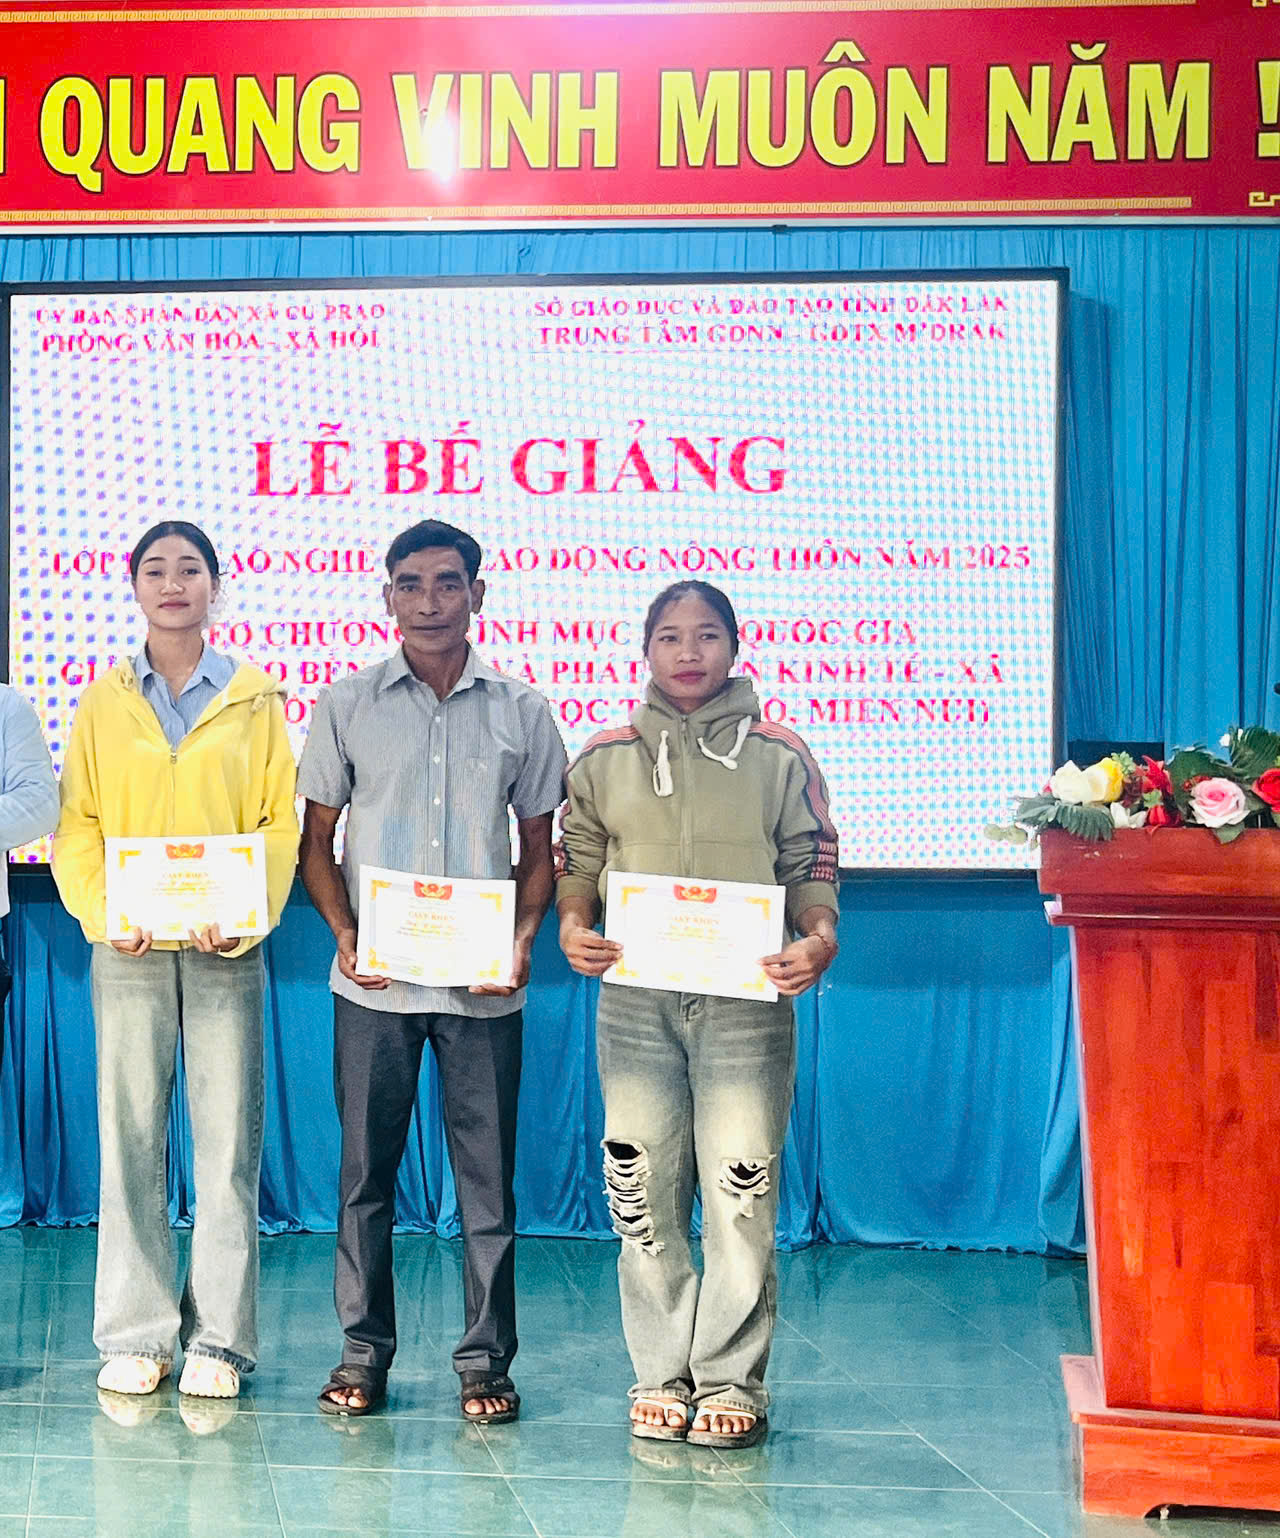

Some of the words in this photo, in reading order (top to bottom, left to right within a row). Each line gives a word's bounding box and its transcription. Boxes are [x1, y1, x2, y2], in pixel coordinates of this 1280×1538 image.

[39, 74, 361, 194] QUANG
[390, 70, 619, 170] VINH
[658, 39, 948, 168] MUÔN
[986, 41, 1211, 164] NĂM
[1256, 58, 1280, 159] !
[539, 326, 630, 346] TRUNG
[249, 421, 353, 496] LỄ
[378, 420, 484, 496] BẾ
[511, 418, 789, 496] GIẢNG
[228, 549, 273, 579] ẠO
[963, 543, 1031, 570] 2025
[553, 619, 631, 651] MỤC
[853, 618, 918, 646] GIA
[552, 653, 643, 684] PHÁT
[776, 659, 867, 684] KINH
